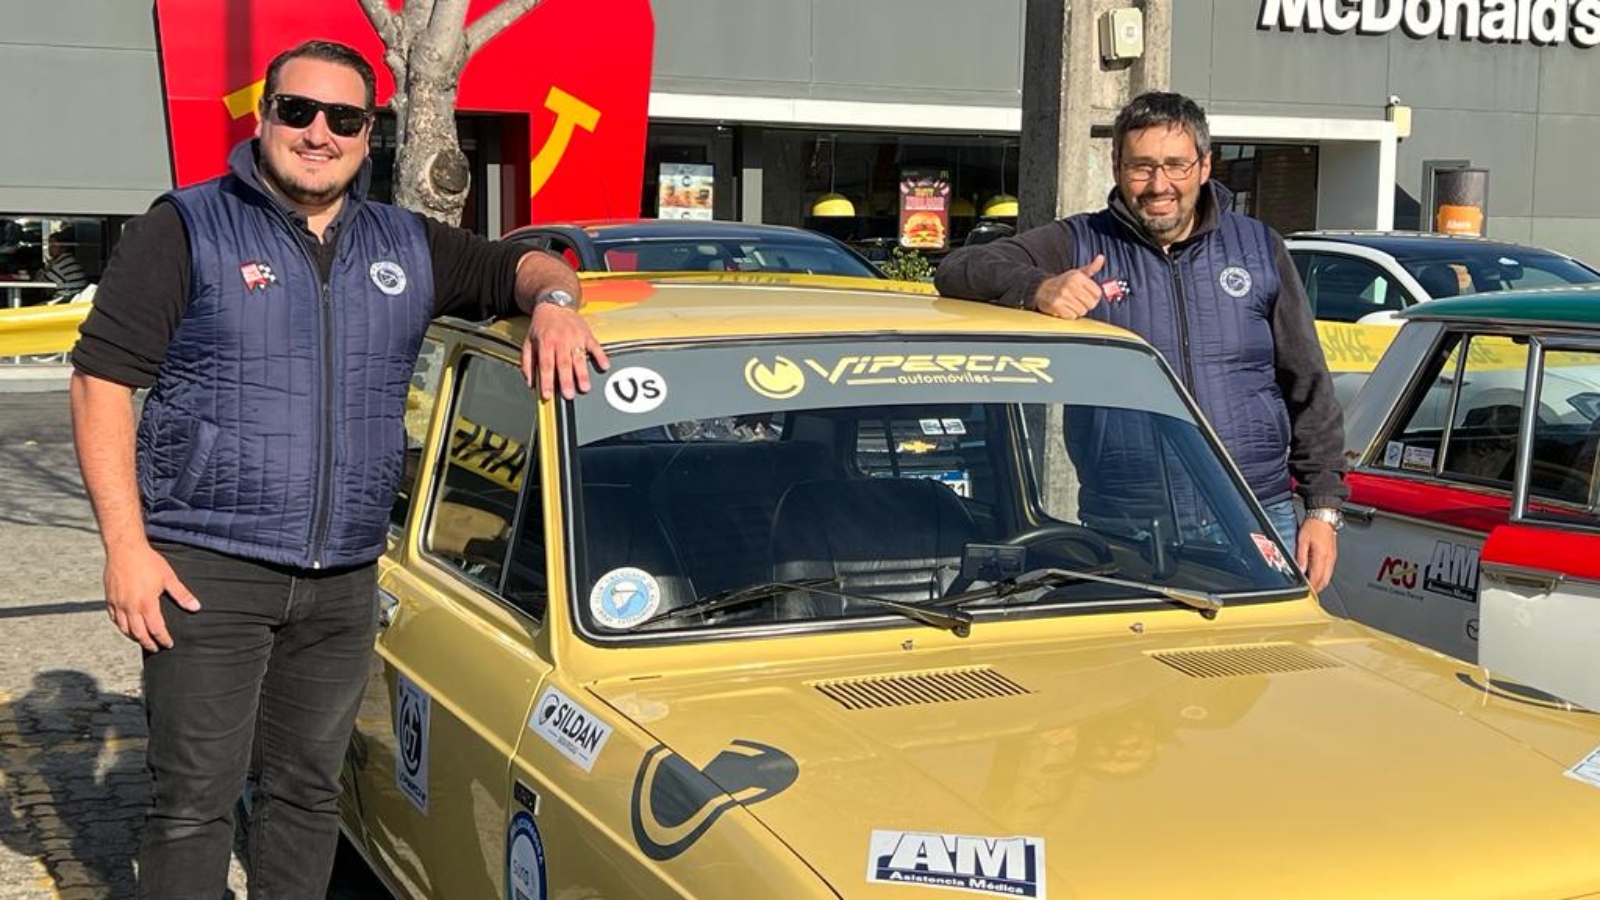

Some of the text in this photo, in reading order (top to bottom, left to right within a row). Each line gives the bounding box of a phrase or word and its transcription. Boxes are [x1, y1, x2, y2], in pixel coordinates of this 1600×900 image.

[1260, 0, 1600, 46] McDonalds
[804, 355, 1054, 385] VIPERCAR
[898, 374, 991, 386] automóviles
[1428, 540, 1480, 590] AM
[552, 703, 604, 754] SILDAN
[888, 833, 1026, 881] AM
[889, 871, 1024, 895] Asistencia Médica
